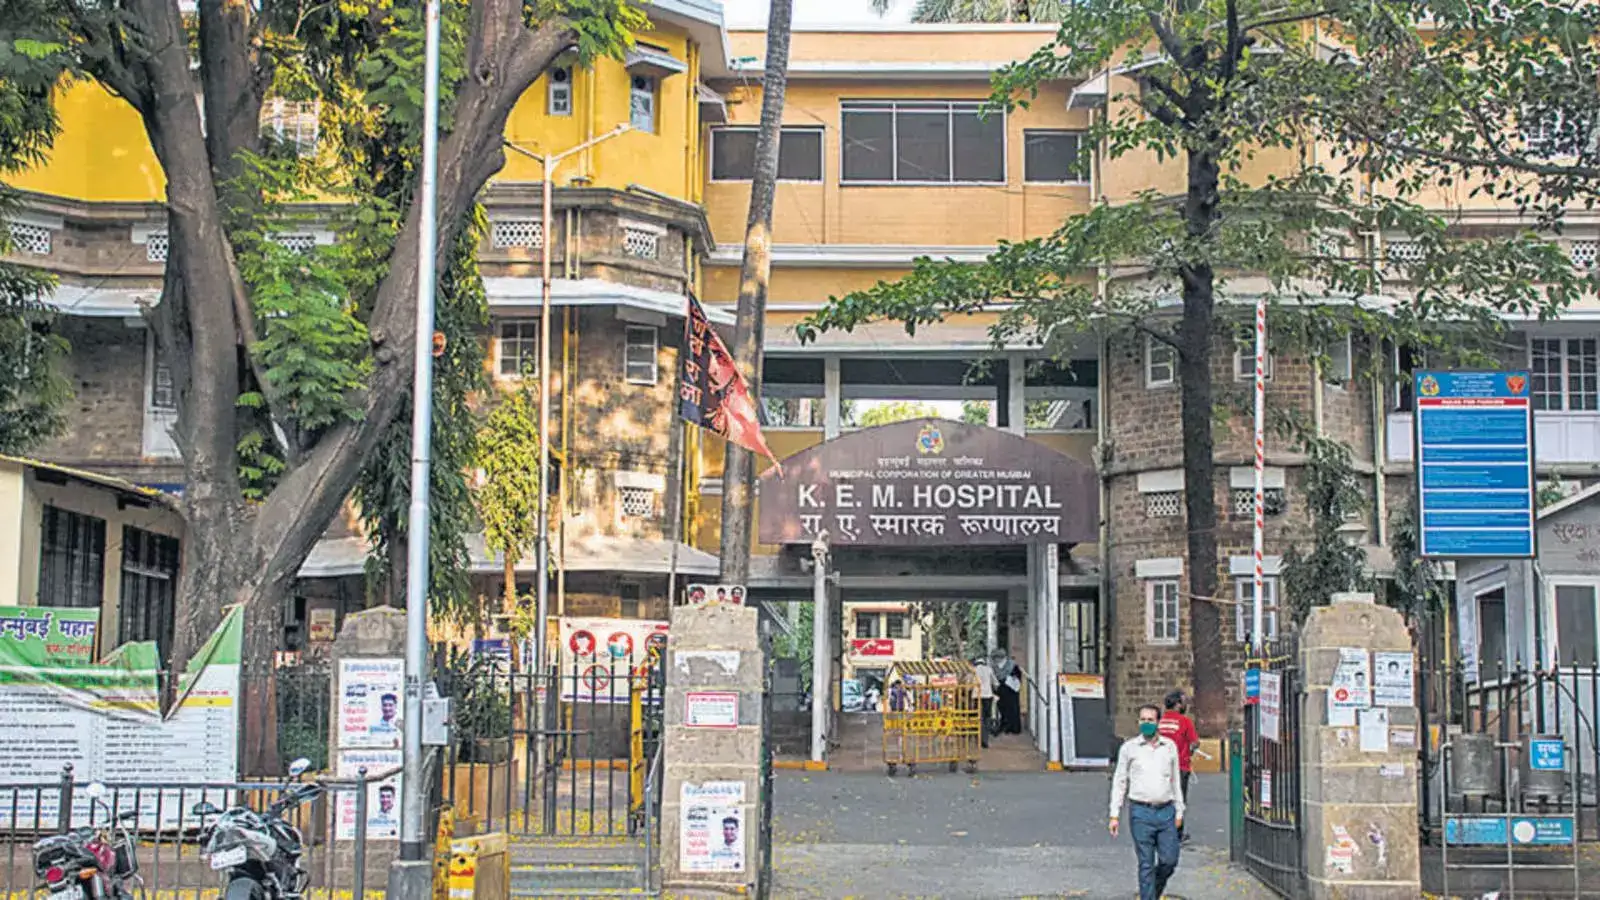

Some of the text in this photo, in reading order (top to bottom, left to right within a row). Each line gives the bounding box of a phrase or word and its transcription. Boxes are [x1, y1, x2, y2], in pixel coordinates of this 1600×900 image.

[829, 470, 1031, 479] MUNICIPAL CORPORATION OF GREATER MUMBAI
[799, 484, 1062, 508] K. E. M. HOSPITAL
[869, 515, 946, 536] स्मारक
